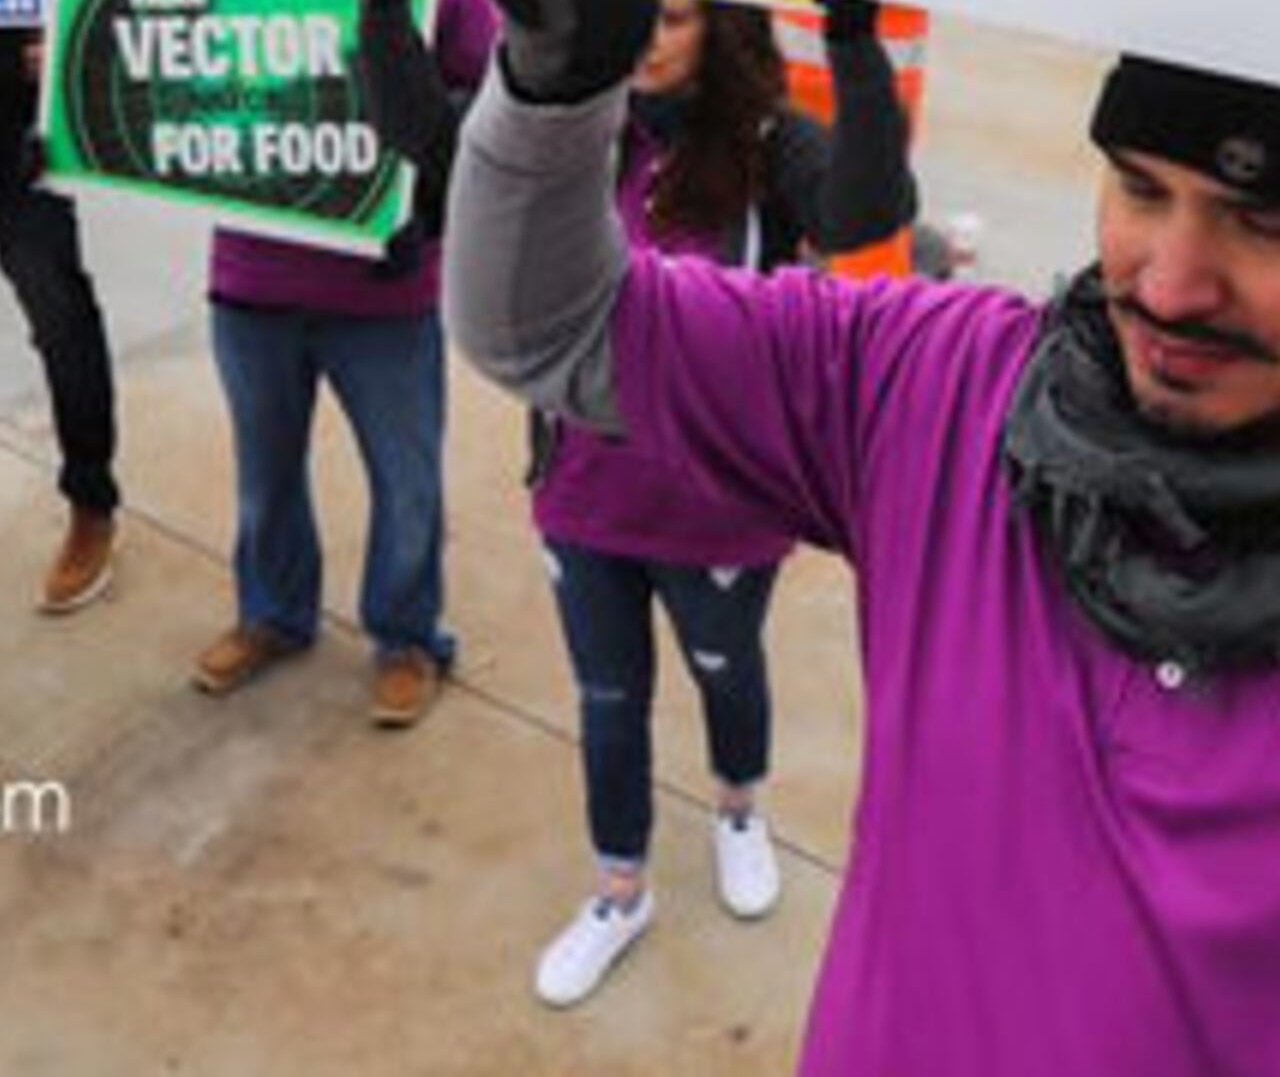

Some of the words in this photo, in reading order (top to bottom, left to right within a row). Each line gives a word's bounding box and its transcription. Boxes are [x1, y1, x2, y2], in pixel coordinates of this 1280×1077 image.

[113, 12, 346, 80] VECTOR
[152, 121, 244, 174] FOR
[252, 121, 379, 175] FOOD
